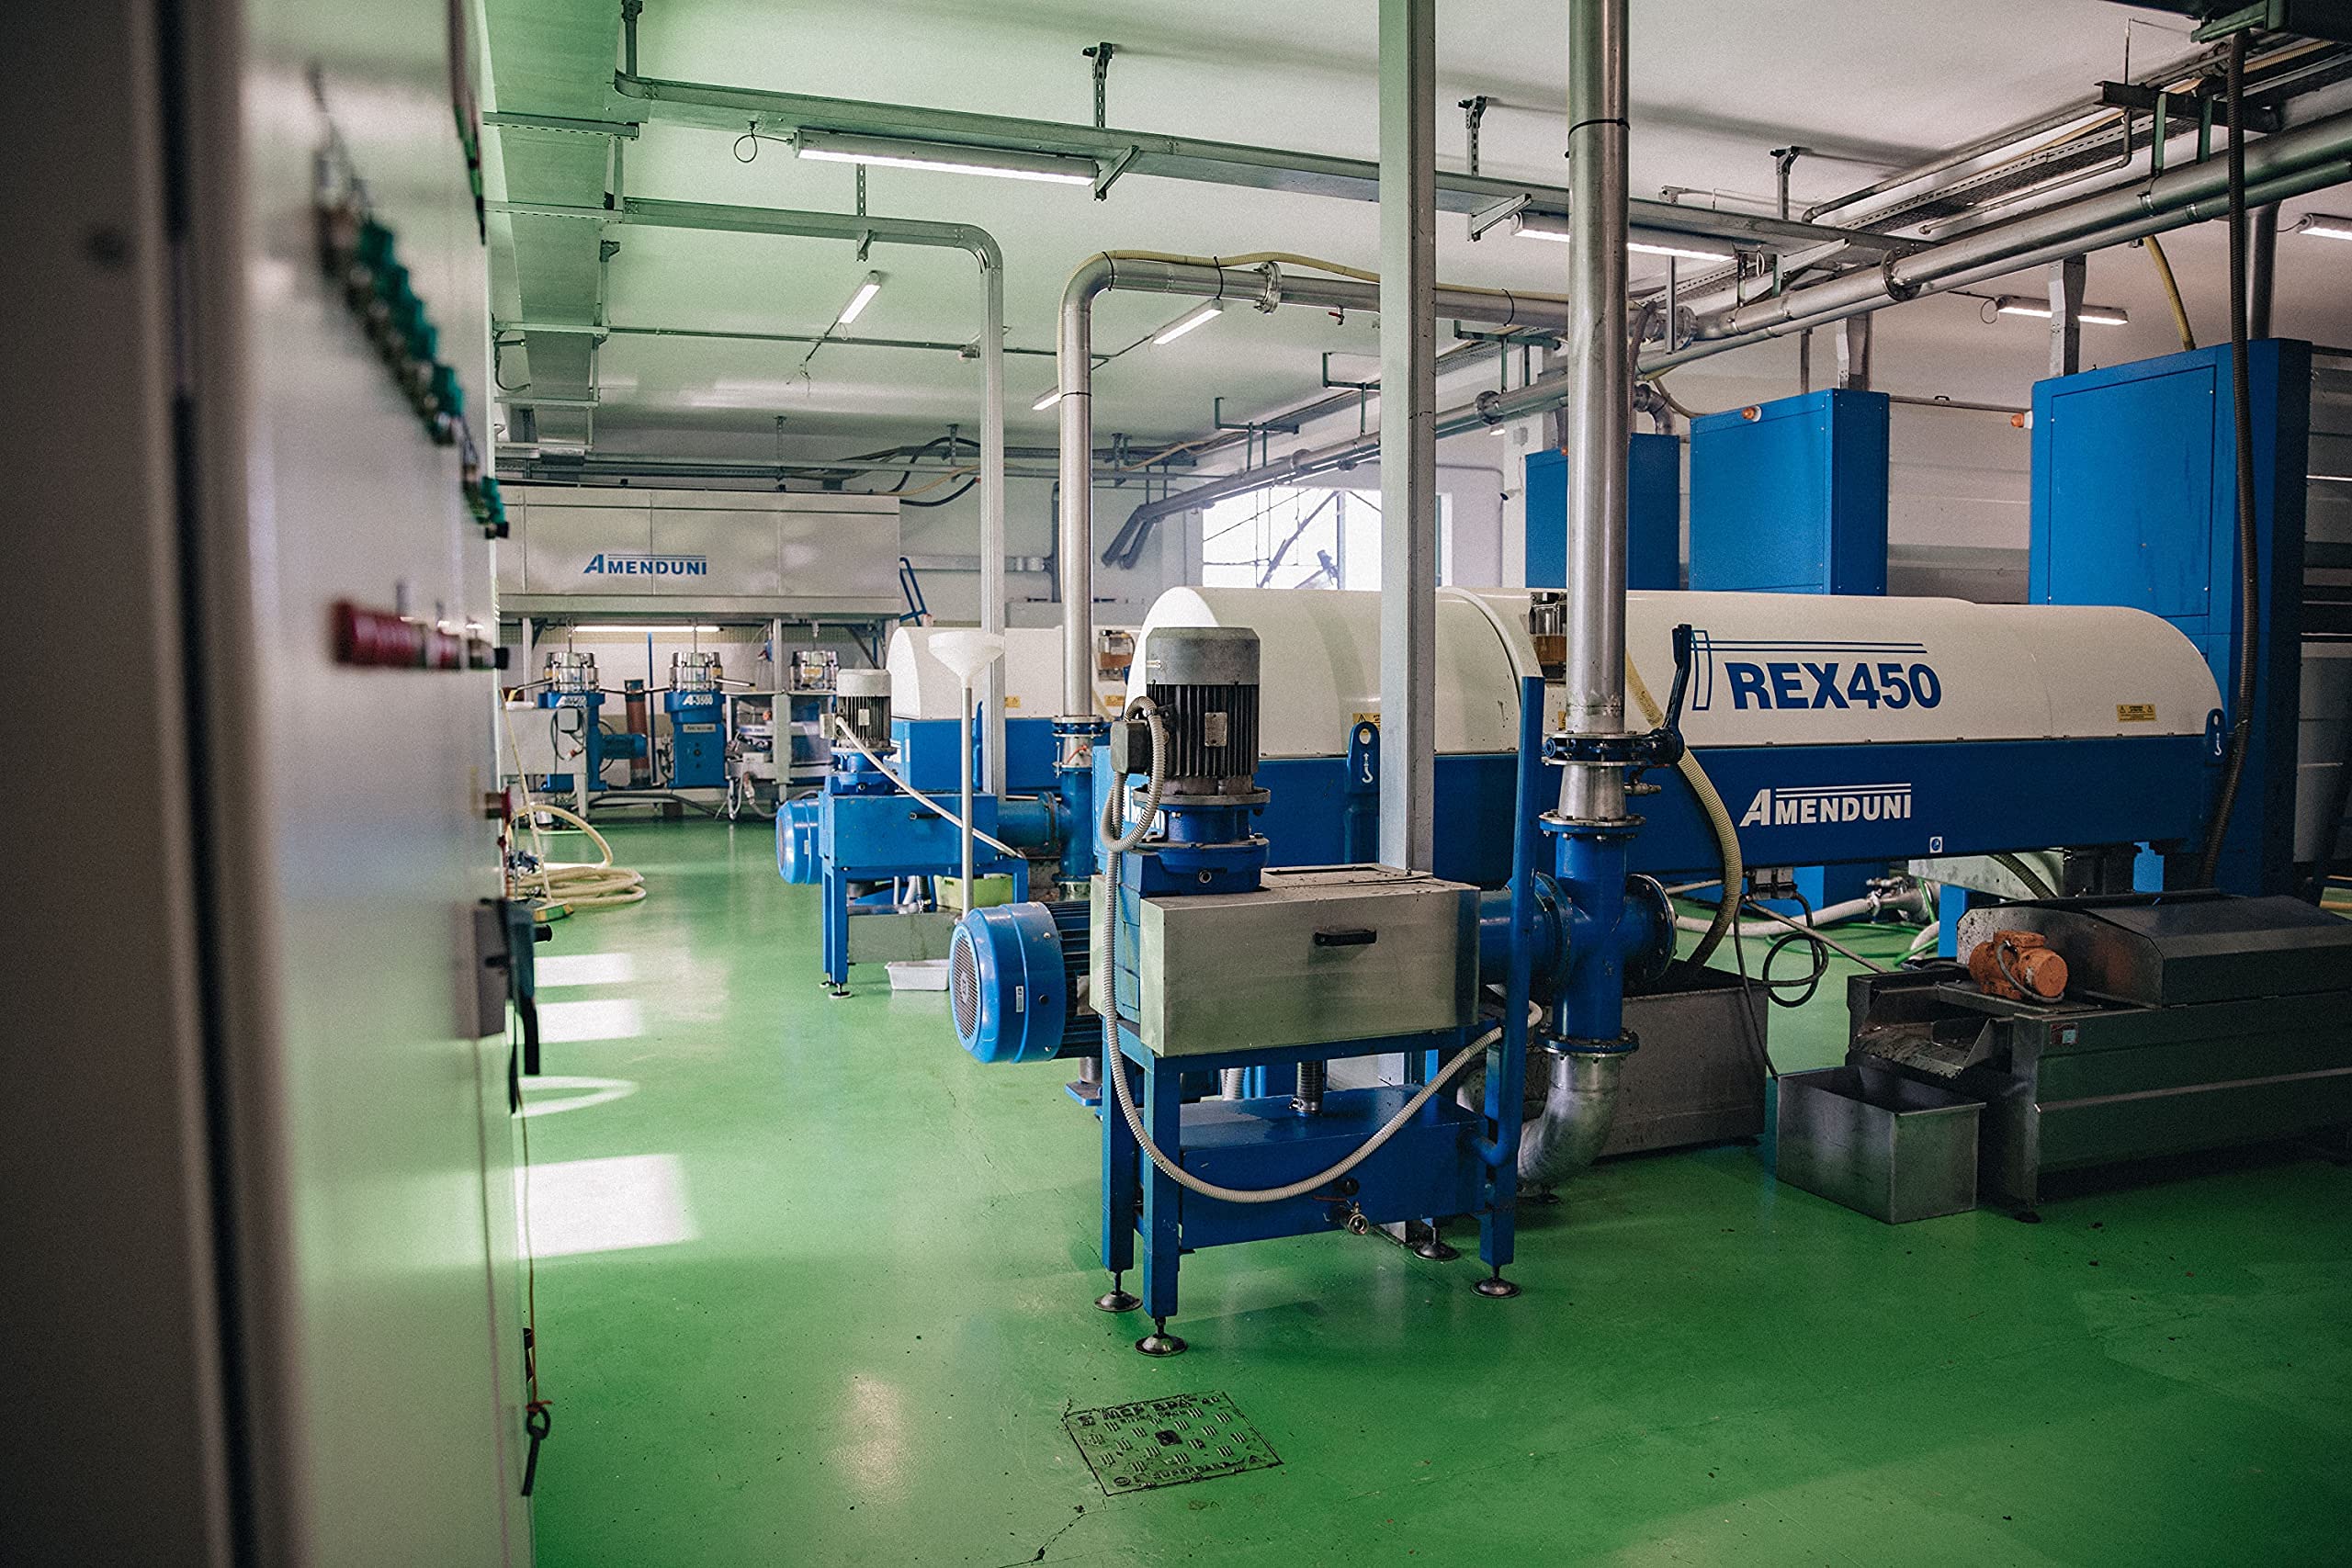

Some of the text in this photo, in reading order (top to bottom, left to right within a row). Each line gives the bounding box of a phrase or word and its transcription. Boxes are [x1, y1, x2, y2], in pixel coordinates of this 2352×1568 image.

[583, 554, 707, 575] AMENDUNI
[1724, 662, 1941, 709] REX450
[1739, 788, 1912, 828] AMENDUNI
